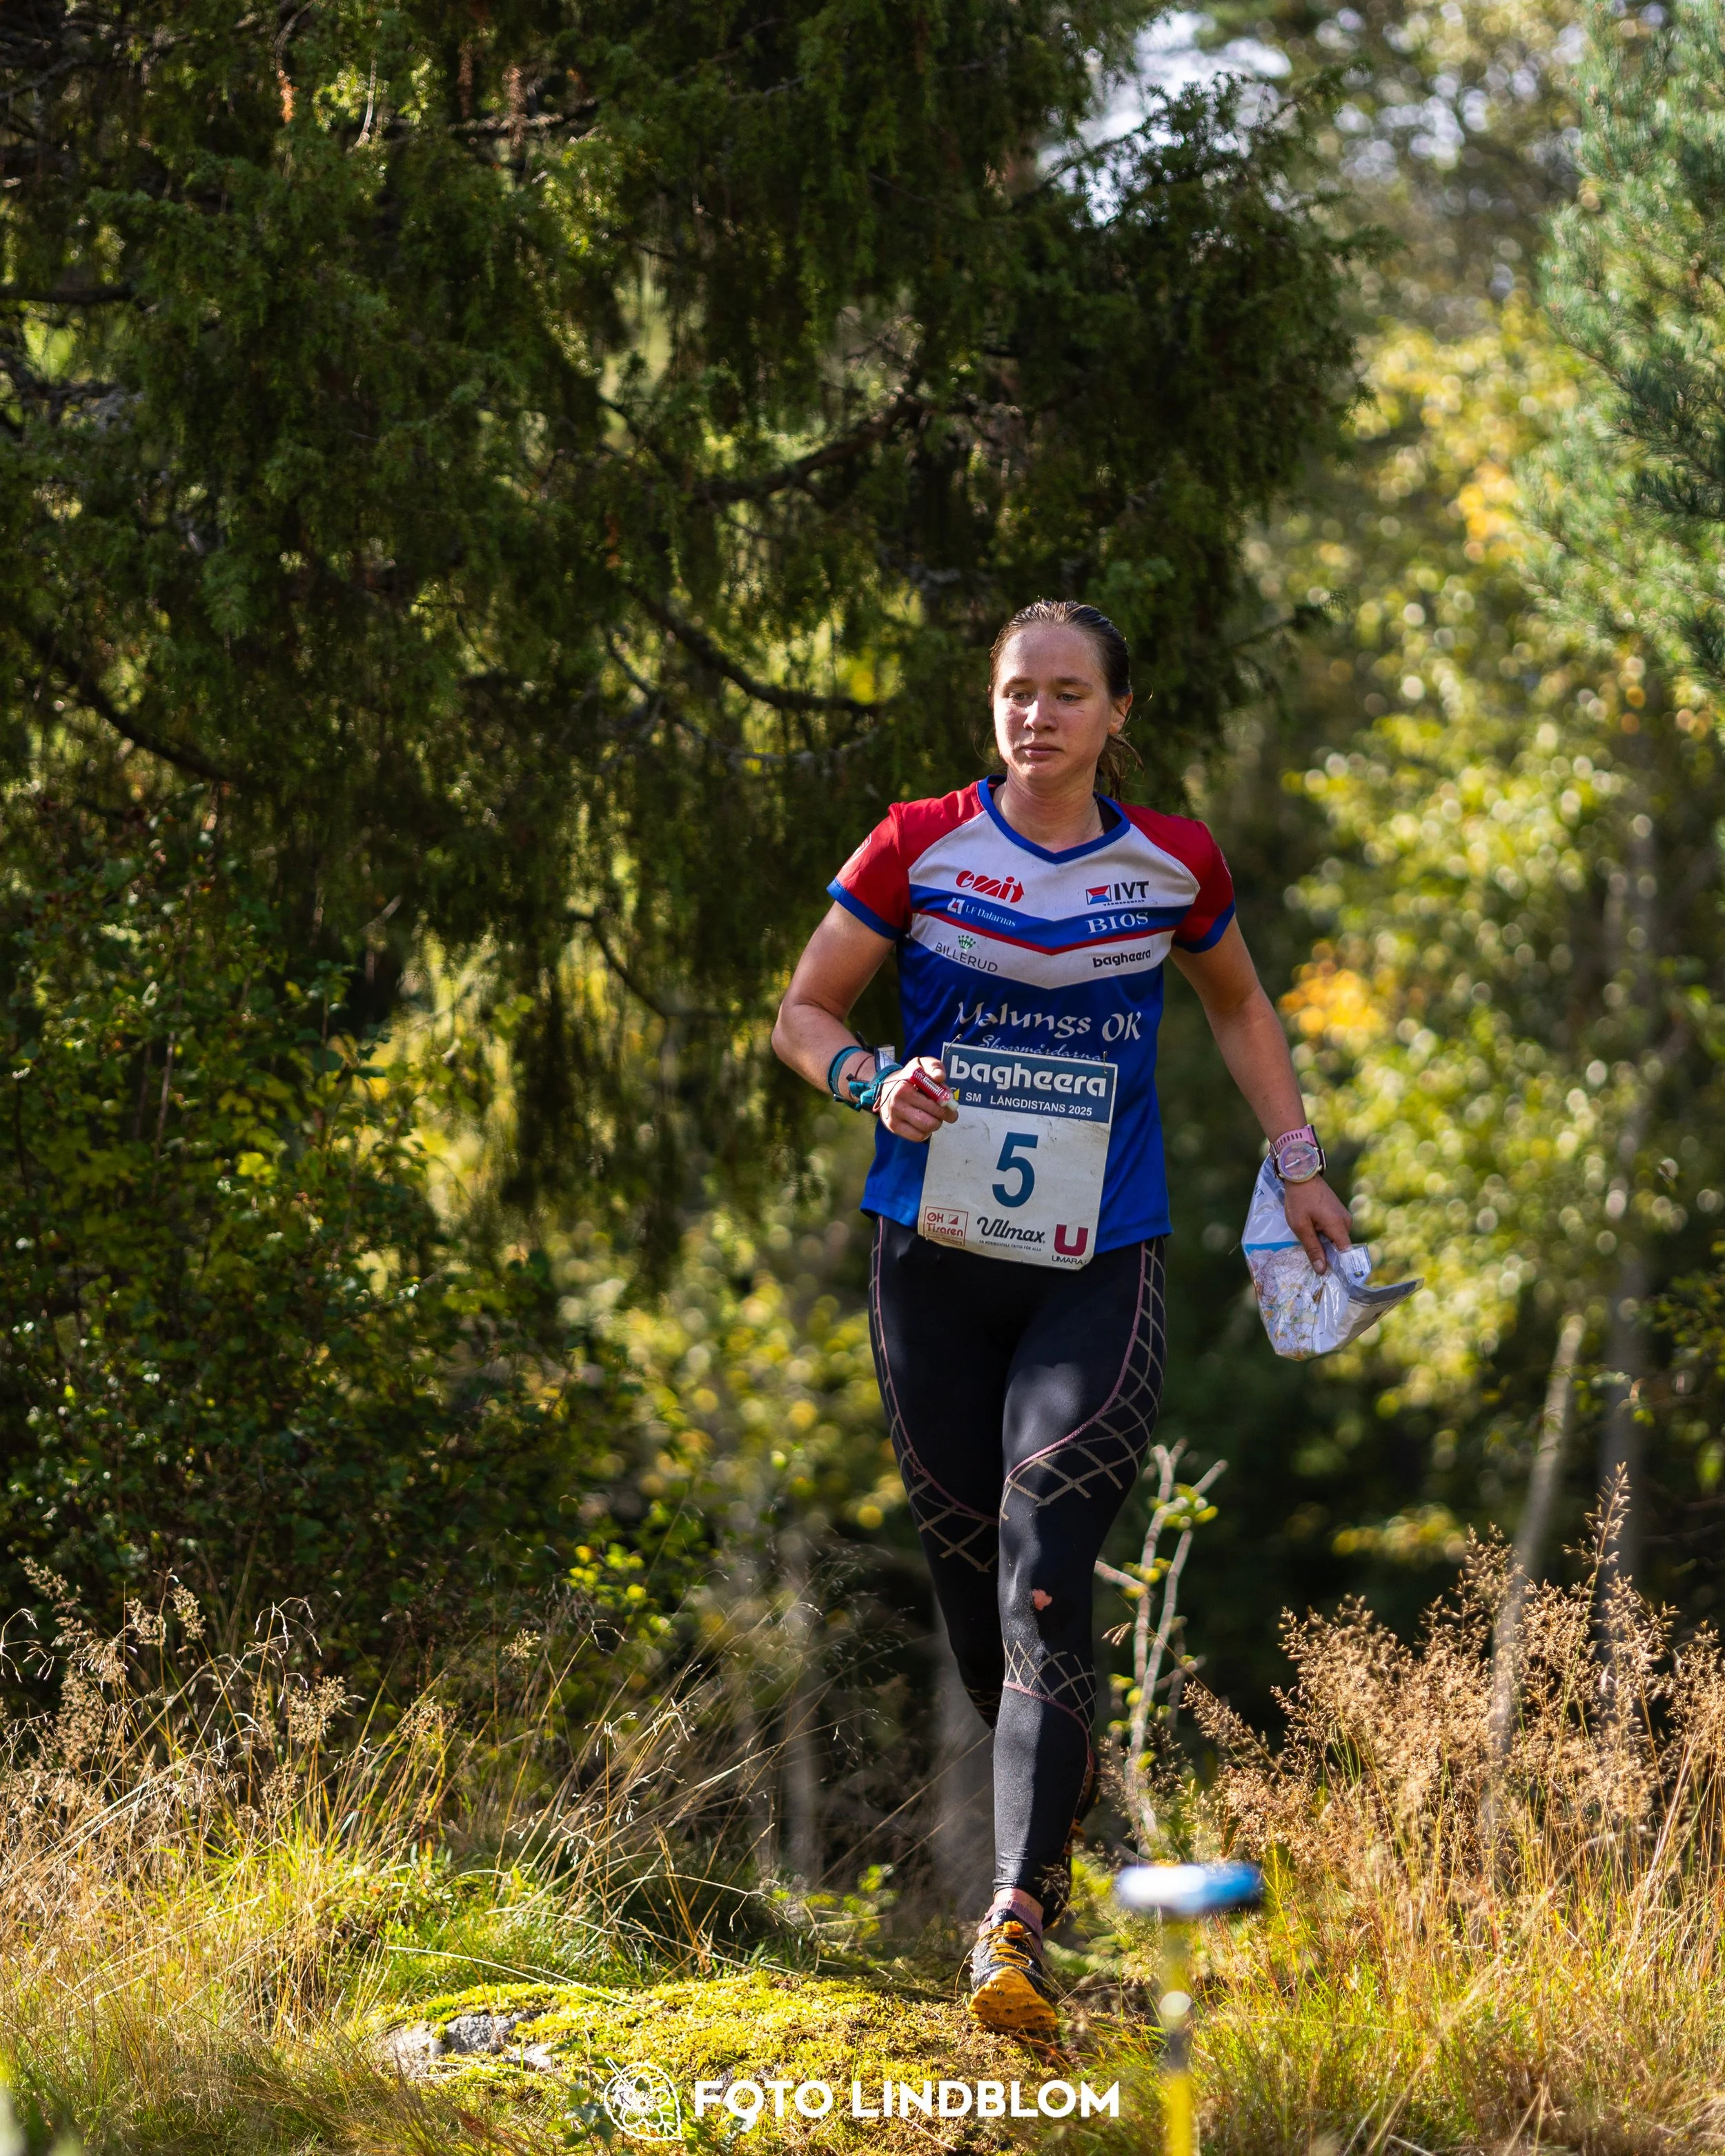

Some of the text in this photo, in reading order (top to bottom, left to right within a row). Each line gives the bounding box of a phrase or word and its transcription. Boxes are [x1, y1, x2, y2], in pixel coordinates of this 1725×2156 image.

[956, 870, 1025, 903] emit
[1114, 880, 1150, 901] IVT
[965, 904, 1017, 927] LF Dalarnas
[1085, 911, 1149, 933] BIOS
[935, 942, 998, 973] BILLERUD
[1092, 949, 1151, 968] bagheera
[954, 1001, 1142, 1042] Malungs OK
[949, 1055, 1107, 1098] bagheera
[965, 1091, 1093, 1116] SM LÅNGDISTANS 2025
[992, 1131, 1039, 1208] 5
[927, 1222, 963, 1237] Tisaren
[976, 1216, 1045, 1243] Ullmax
[1052, 1254, 1083, 1265] UMARA
